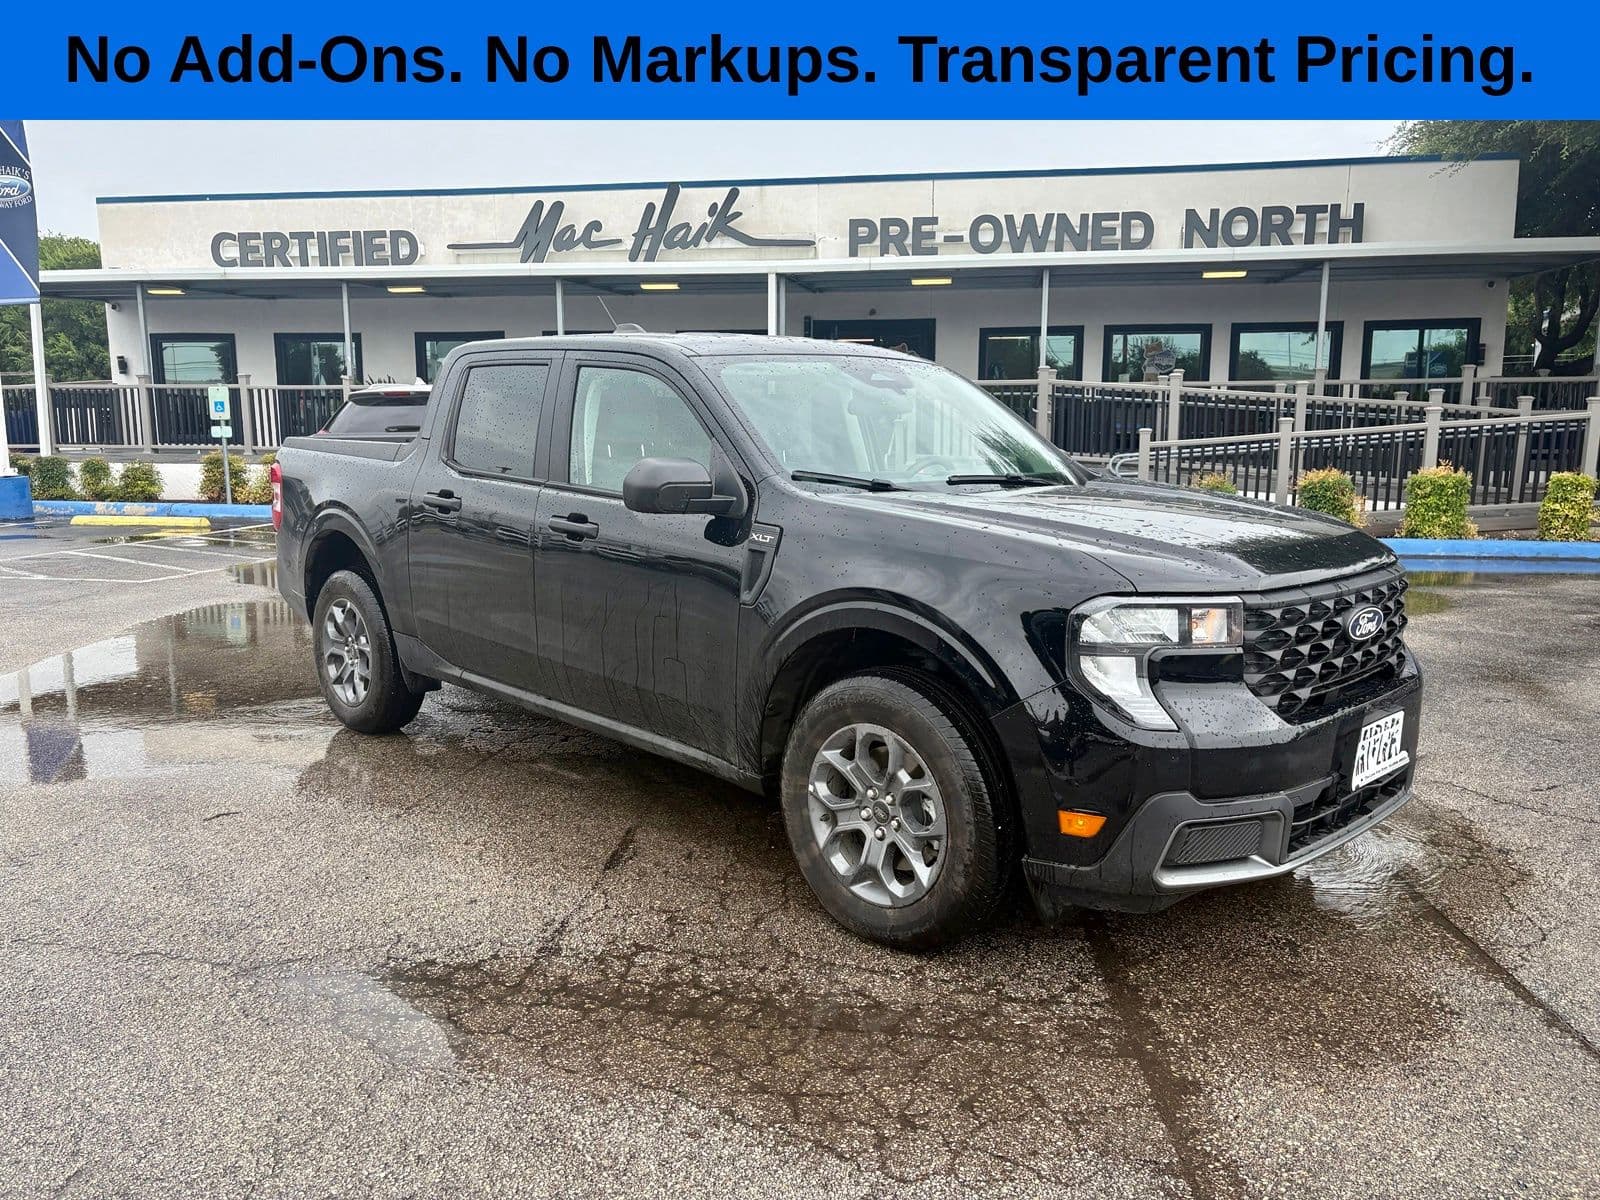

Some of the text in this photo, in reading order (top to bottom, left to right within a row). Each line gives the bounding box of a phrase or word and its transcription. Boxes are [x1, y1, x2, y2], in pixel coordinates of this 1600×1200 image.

[210, 202, 1365, 267] CERTIFIED PRE-OWNED NORTH
[448, 183, 816, 262] Mac Haik
[750, 533, 775, 542] XLT
[1356, 612, 1379, 636] Ford
